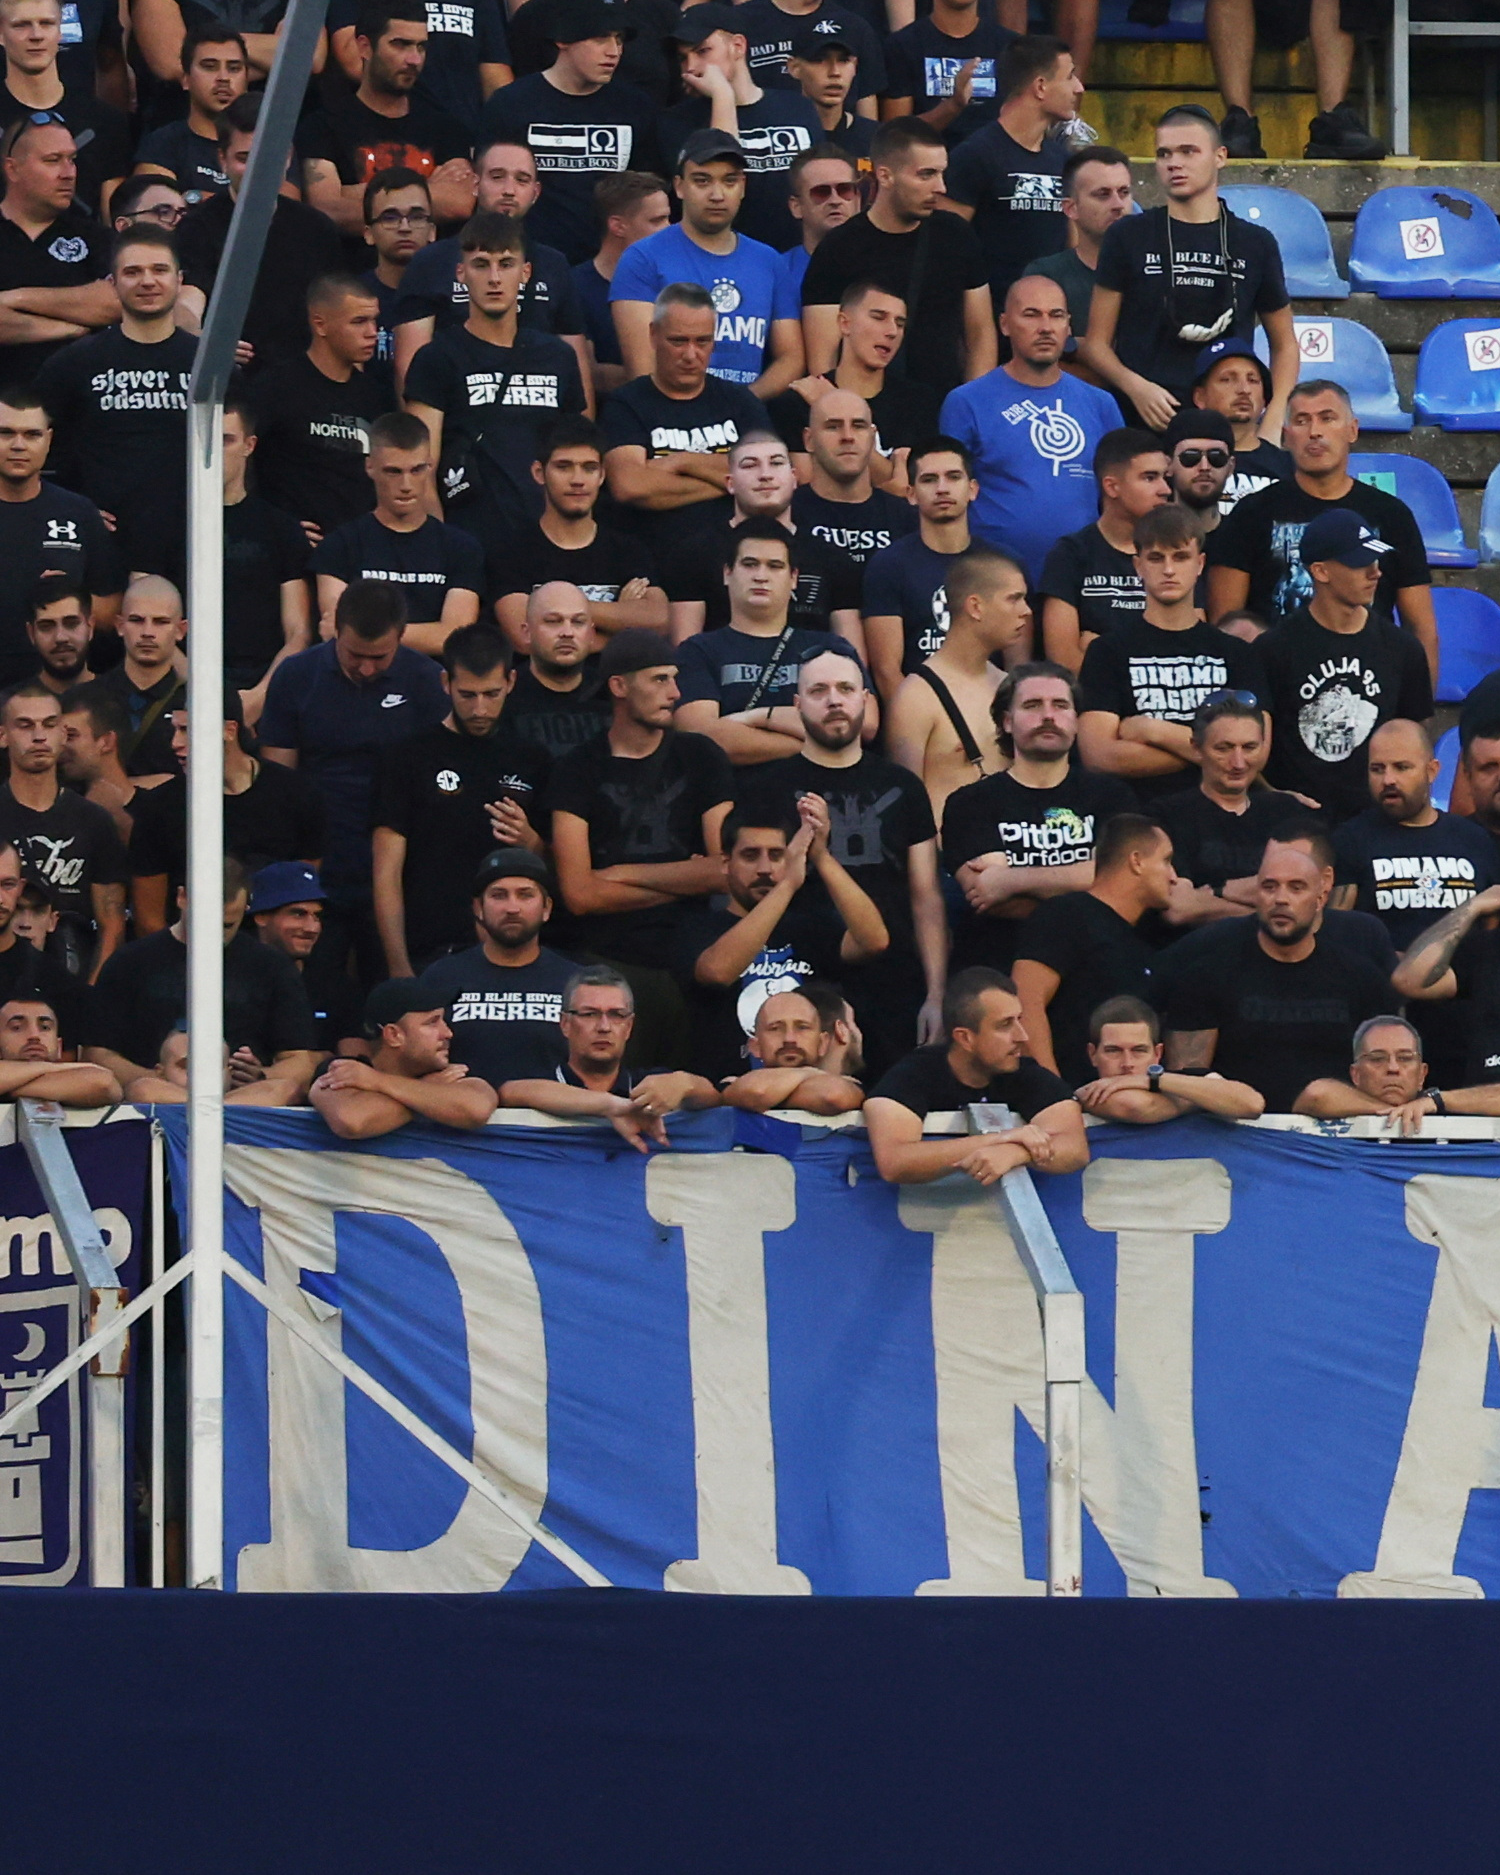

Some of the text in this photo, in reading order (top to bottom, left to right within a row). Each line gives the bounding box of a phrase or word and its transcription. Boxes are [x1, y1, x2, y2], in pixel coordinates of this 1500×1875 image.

[442, 3, 474, 17] BOYS
[750, 44, 776, 57] BAD
[1009, 199, 1052, 212] BAD BLUE
[1175, 252, 1212, 265] BLUE
[1175, 275, 1216, 289] ZAGREB
[91, 367, 171, 399] sjever
[465, 372, 558, 386] BAD BOYS
[310, 422, 361, 441] NORTH
[651, 419, 739, 450] DINAMO
[811, 525, 892, 550] GUESS
[361, 569, 384, 580] BAD
[417, 572, 446, 585] BOYS
[1083, 576, 1143, 587] BAD BLUE
[1129, 664, 1228, 687] DINAMO
[1298, 657, 1382, 701] OLUJA 95
[1371, 855, 1475, 881] DINAMO
[459, 991, 562, 1005] AD BLUE BOYS
[451, 1002, 562, 1023] ZAGREB
